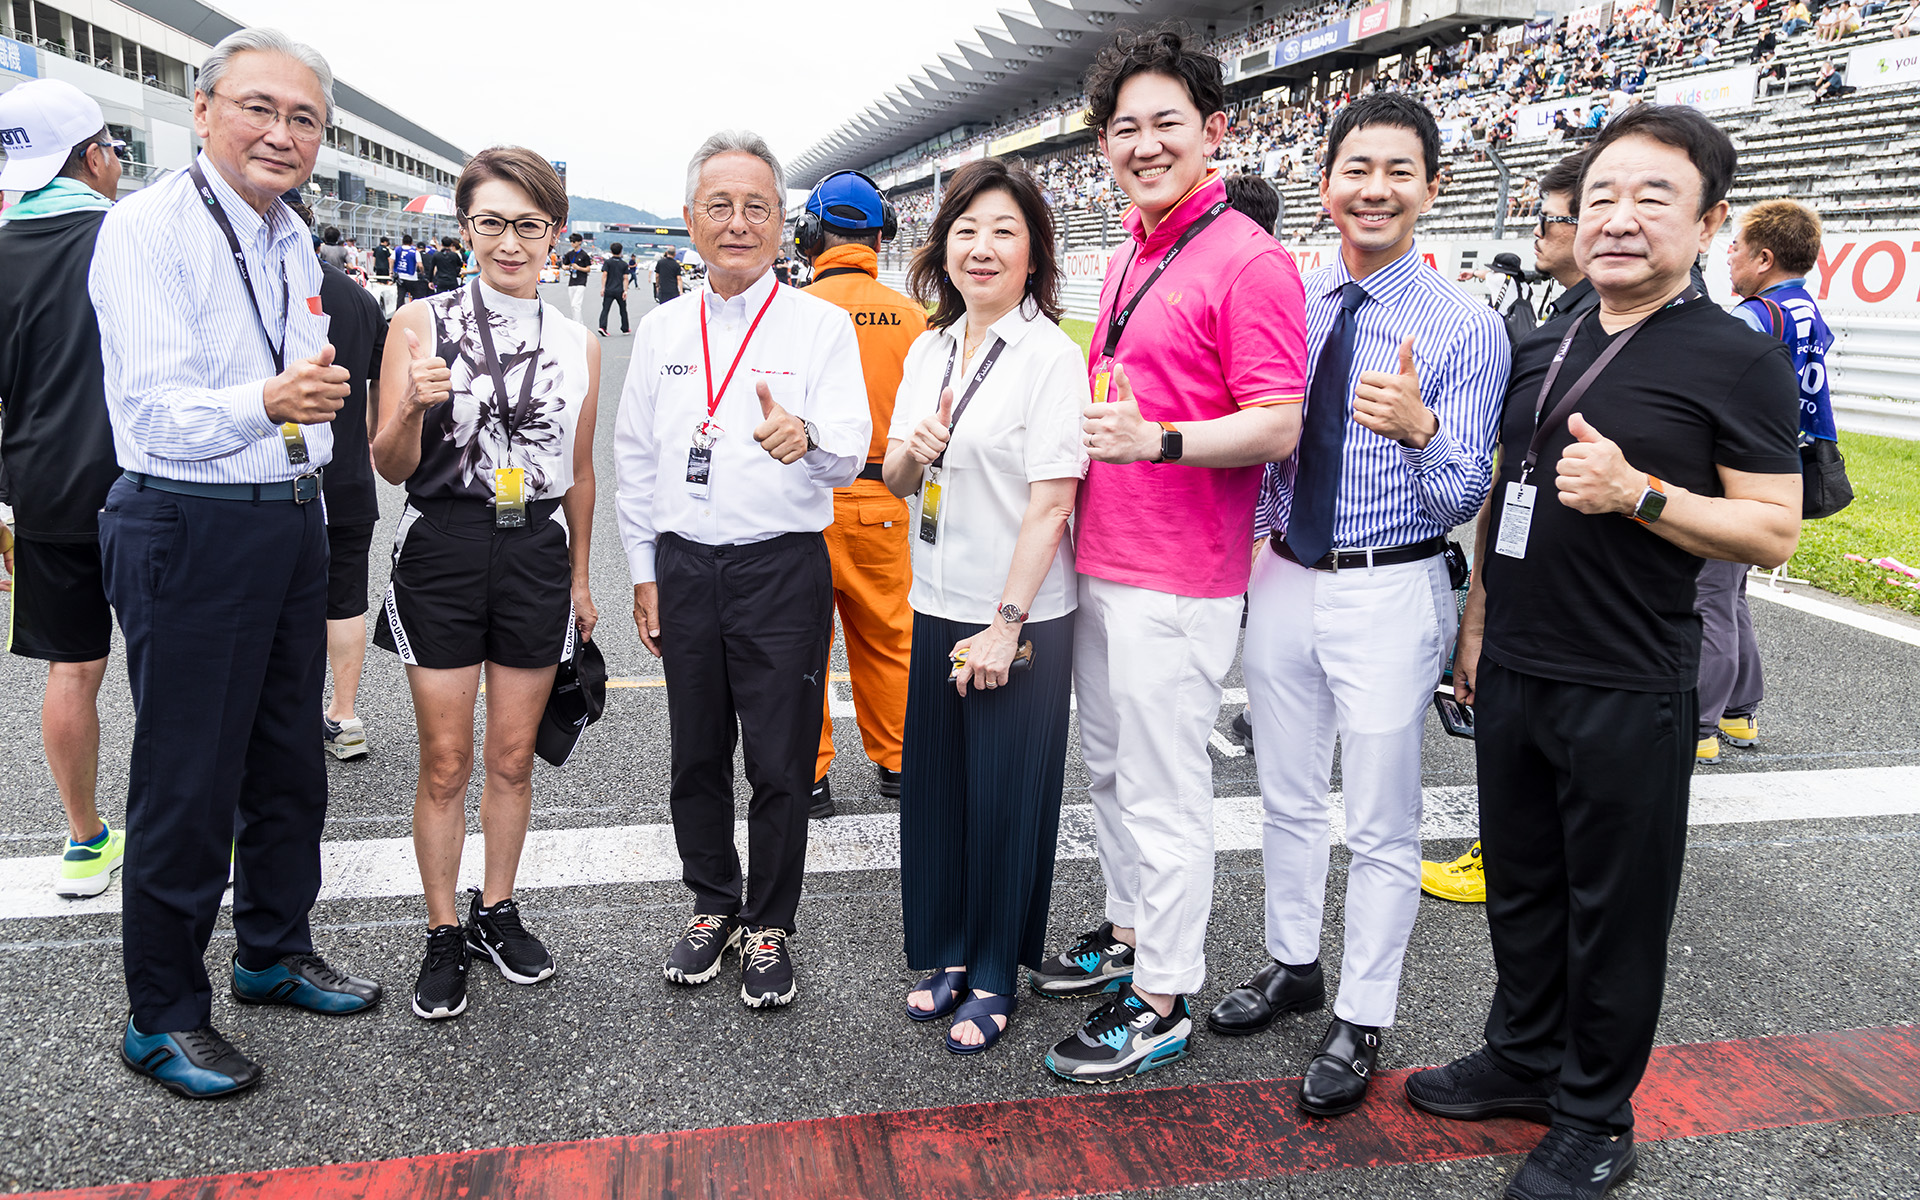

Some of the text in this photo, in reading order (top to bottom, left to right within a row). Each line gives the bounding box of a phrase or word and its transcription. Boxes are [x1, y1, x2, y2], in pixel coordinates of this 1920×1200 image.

[1301, 29, 1338, 53] SUBARU
[1067, 254, 1100, 276] TOYOTA
[387, 590, 411, 660] CUARTO UNITED
